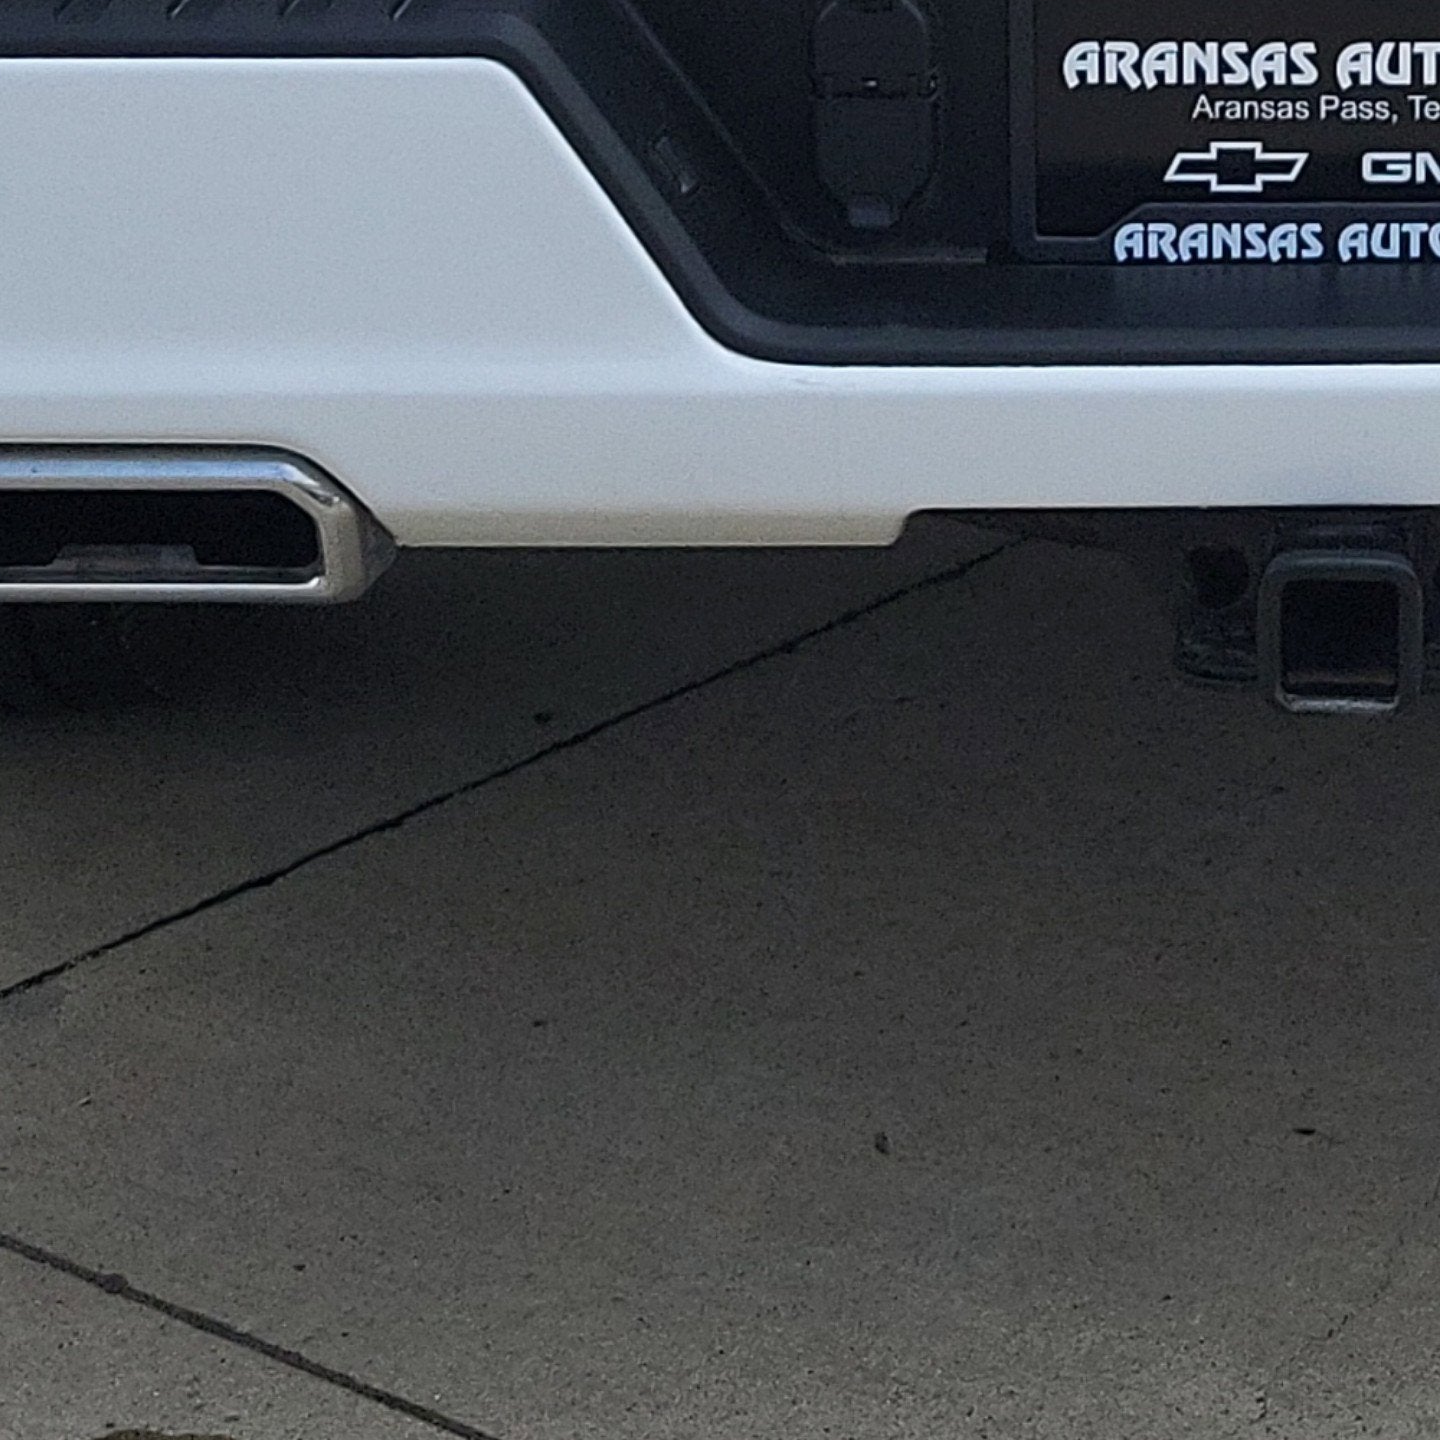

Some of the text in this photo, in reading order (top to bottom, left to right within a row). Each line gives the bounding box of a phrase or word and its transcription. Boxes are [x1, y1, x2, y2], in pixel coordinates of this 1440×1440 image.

[1062, 40, 1319, 91] ARANSAS
[1191, 93, 1311, 121] Aransas
[1318, 93, 1398, 124] Pass,
[1113, 221, 1325, 263] ARANSAS
